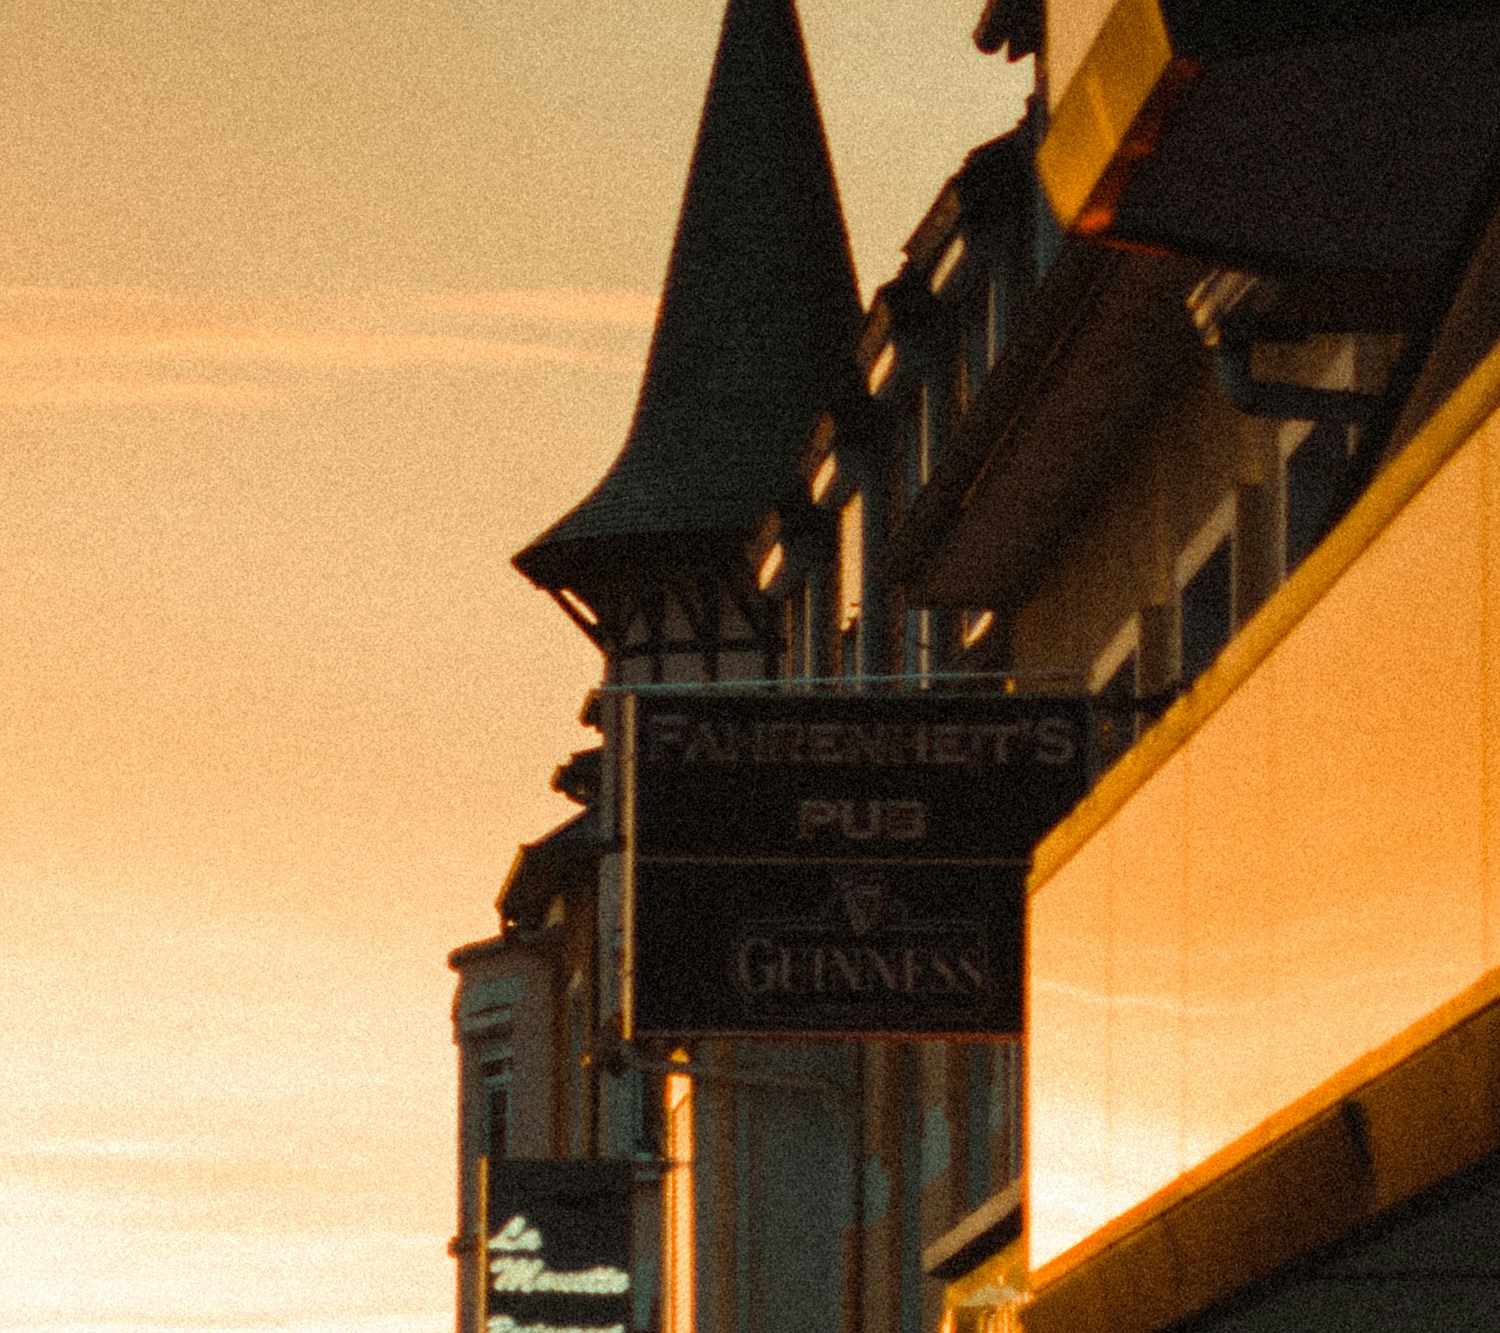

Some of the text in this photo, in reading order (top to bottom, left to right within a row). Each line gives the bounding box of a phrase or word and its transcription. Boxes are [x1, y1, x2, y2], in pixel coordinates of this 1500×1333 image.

[647, 713, 1076, 765] FAHRENHEIT'S
[799, 799, 928, 842] PUB
[736, 936, 985, 995] GUINNESS
